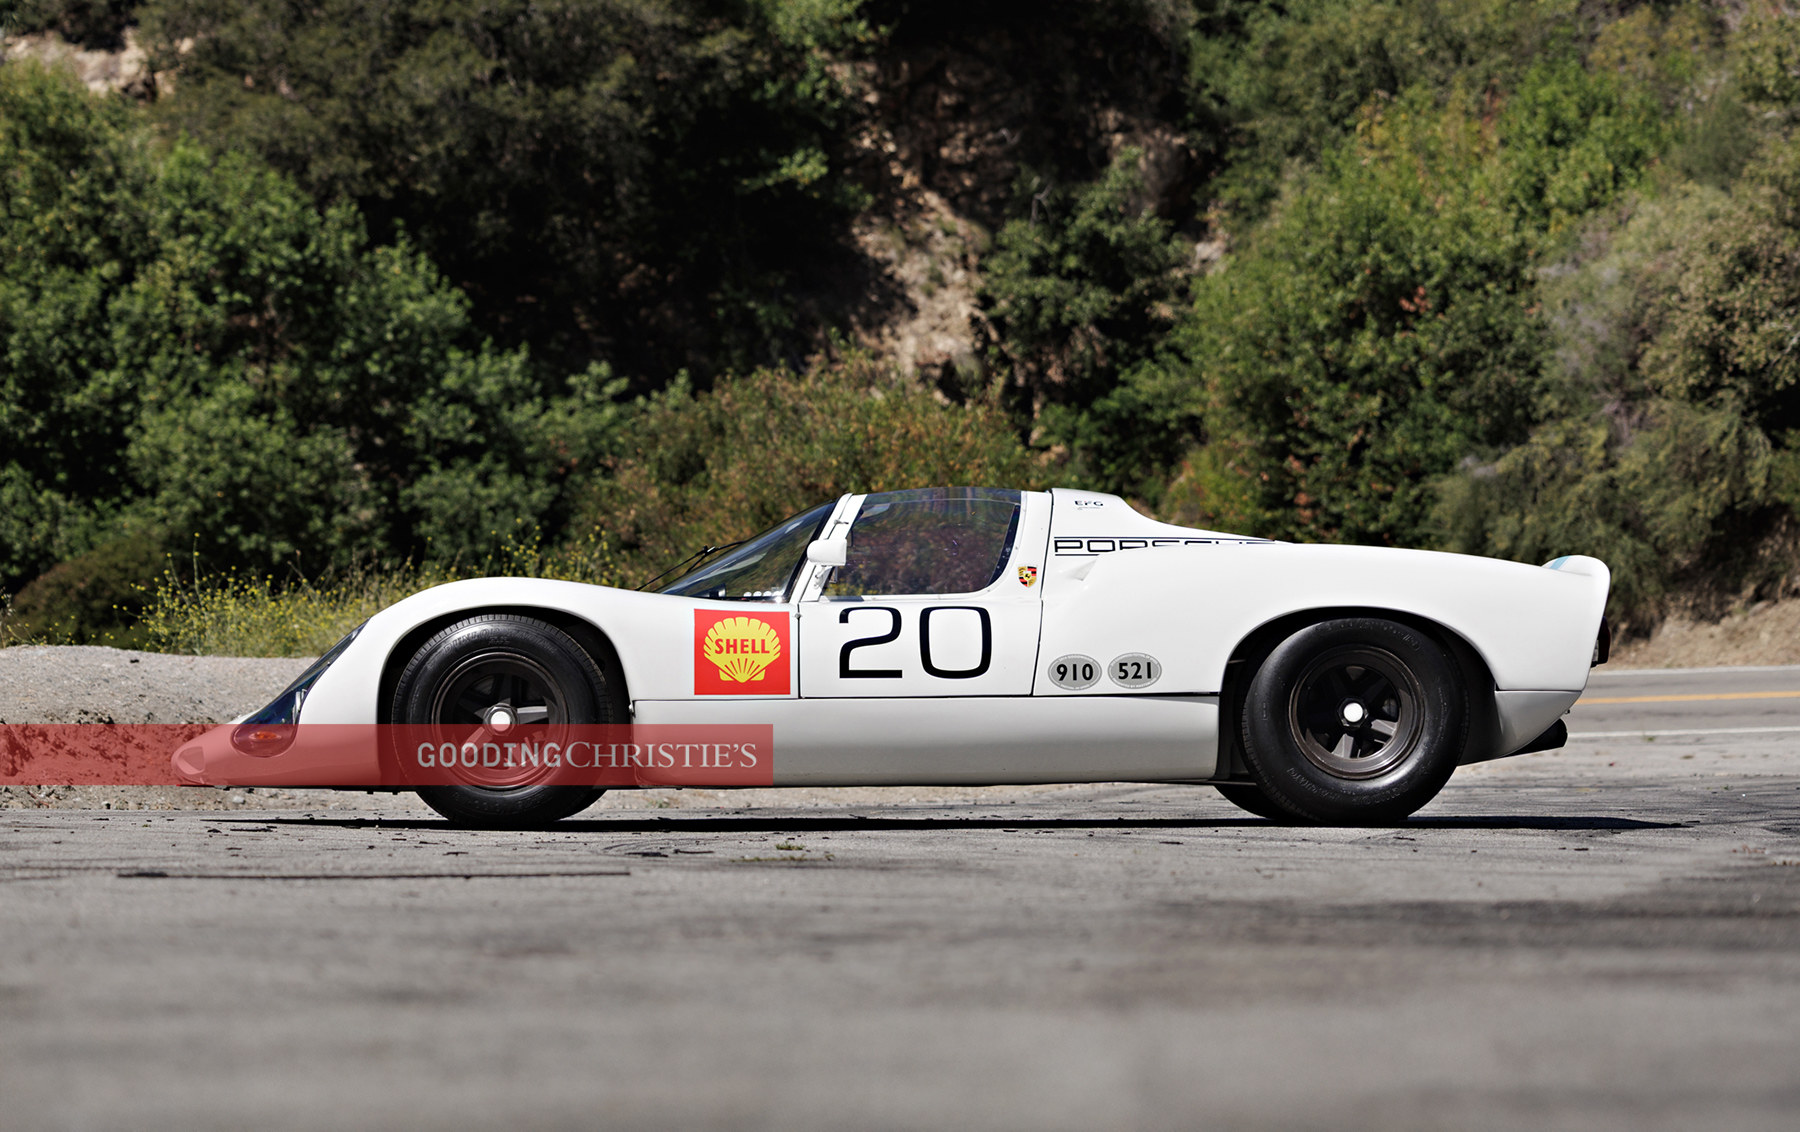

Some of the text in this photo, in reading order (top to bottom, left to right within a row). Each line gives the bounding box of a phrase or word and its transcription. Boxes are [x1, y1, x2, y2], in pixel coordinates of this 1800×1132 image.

[714, 638, 770, 655] SHELL
[839, 606, 992, 679] 20
[1056, 663, 1094, 681] 910
[1118, 662, 1152, 680] 521
